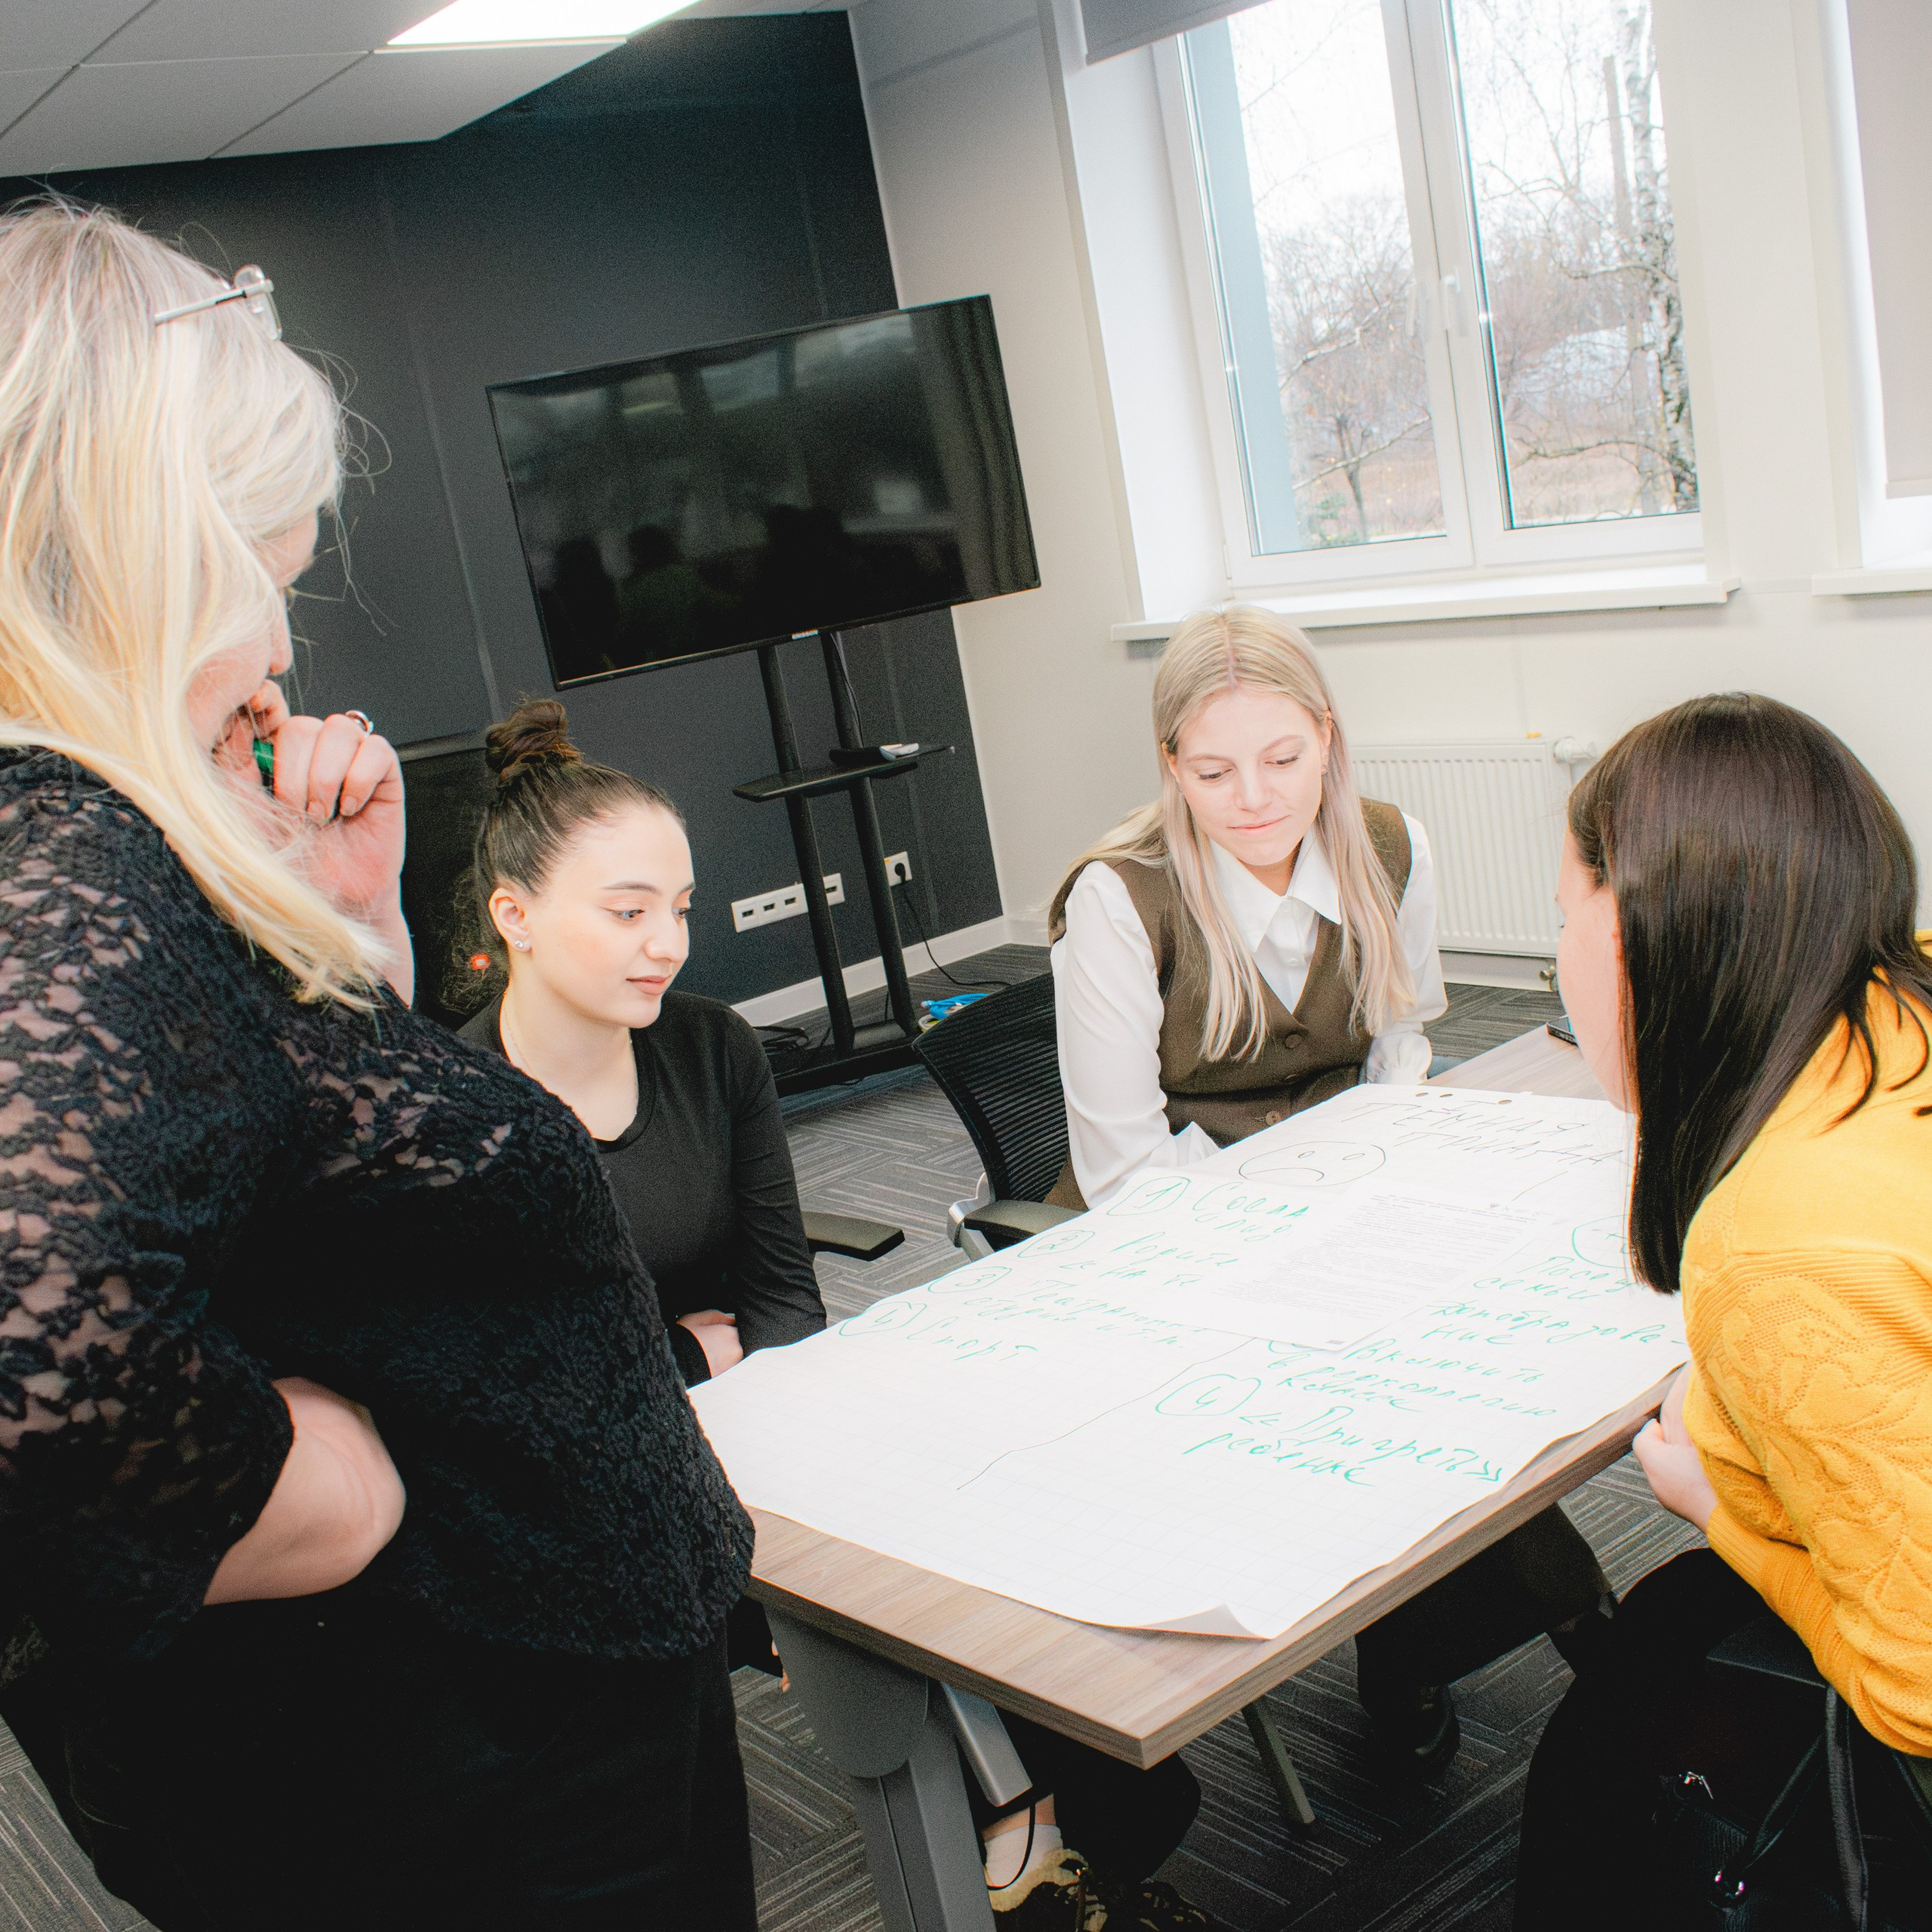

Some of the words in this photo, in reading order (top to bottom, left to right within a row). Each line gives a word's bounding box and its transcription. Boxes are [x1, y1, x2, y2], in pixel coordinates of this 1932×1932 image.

[1392, 1131, 1624, 1165] ТРИАДА
[1110, 1231, 1238, 1267] Родите
[906, 1316, 1038, 1361] Спорт
[1341, 1337, 1545, 1383] Включить
